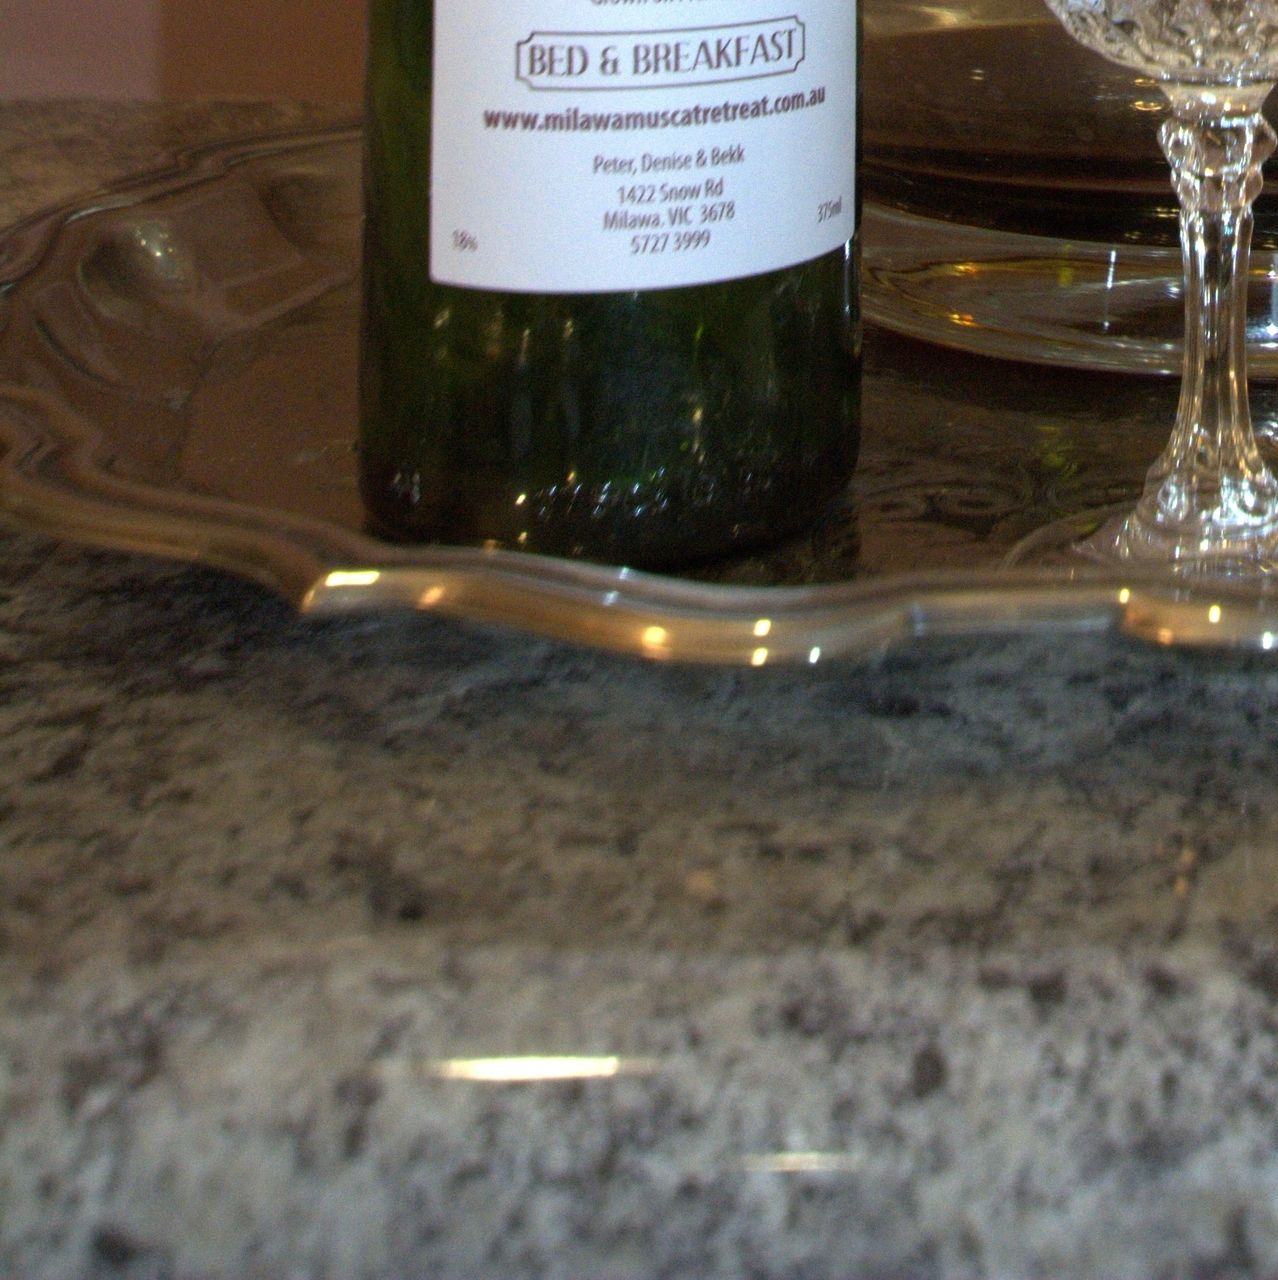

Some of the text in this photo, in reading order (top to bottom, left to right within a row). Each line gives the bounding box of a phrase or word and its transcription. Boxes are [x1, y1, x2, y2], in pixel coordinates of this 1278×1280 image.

[527, 28, 797, 77] BED & BREAKFAST
[483, 86, 826, 132] www.milawamuscatretreat.com.au
[593, 145, 746, 175] Peter, Denise & Bekk
[617, 178, 725, 204] 1422 Snow Rd
[668, 206, 694, 227] VIC
[699, 202, 736, 223] 3678
[630, 230, 711, 255] 5727 3999
